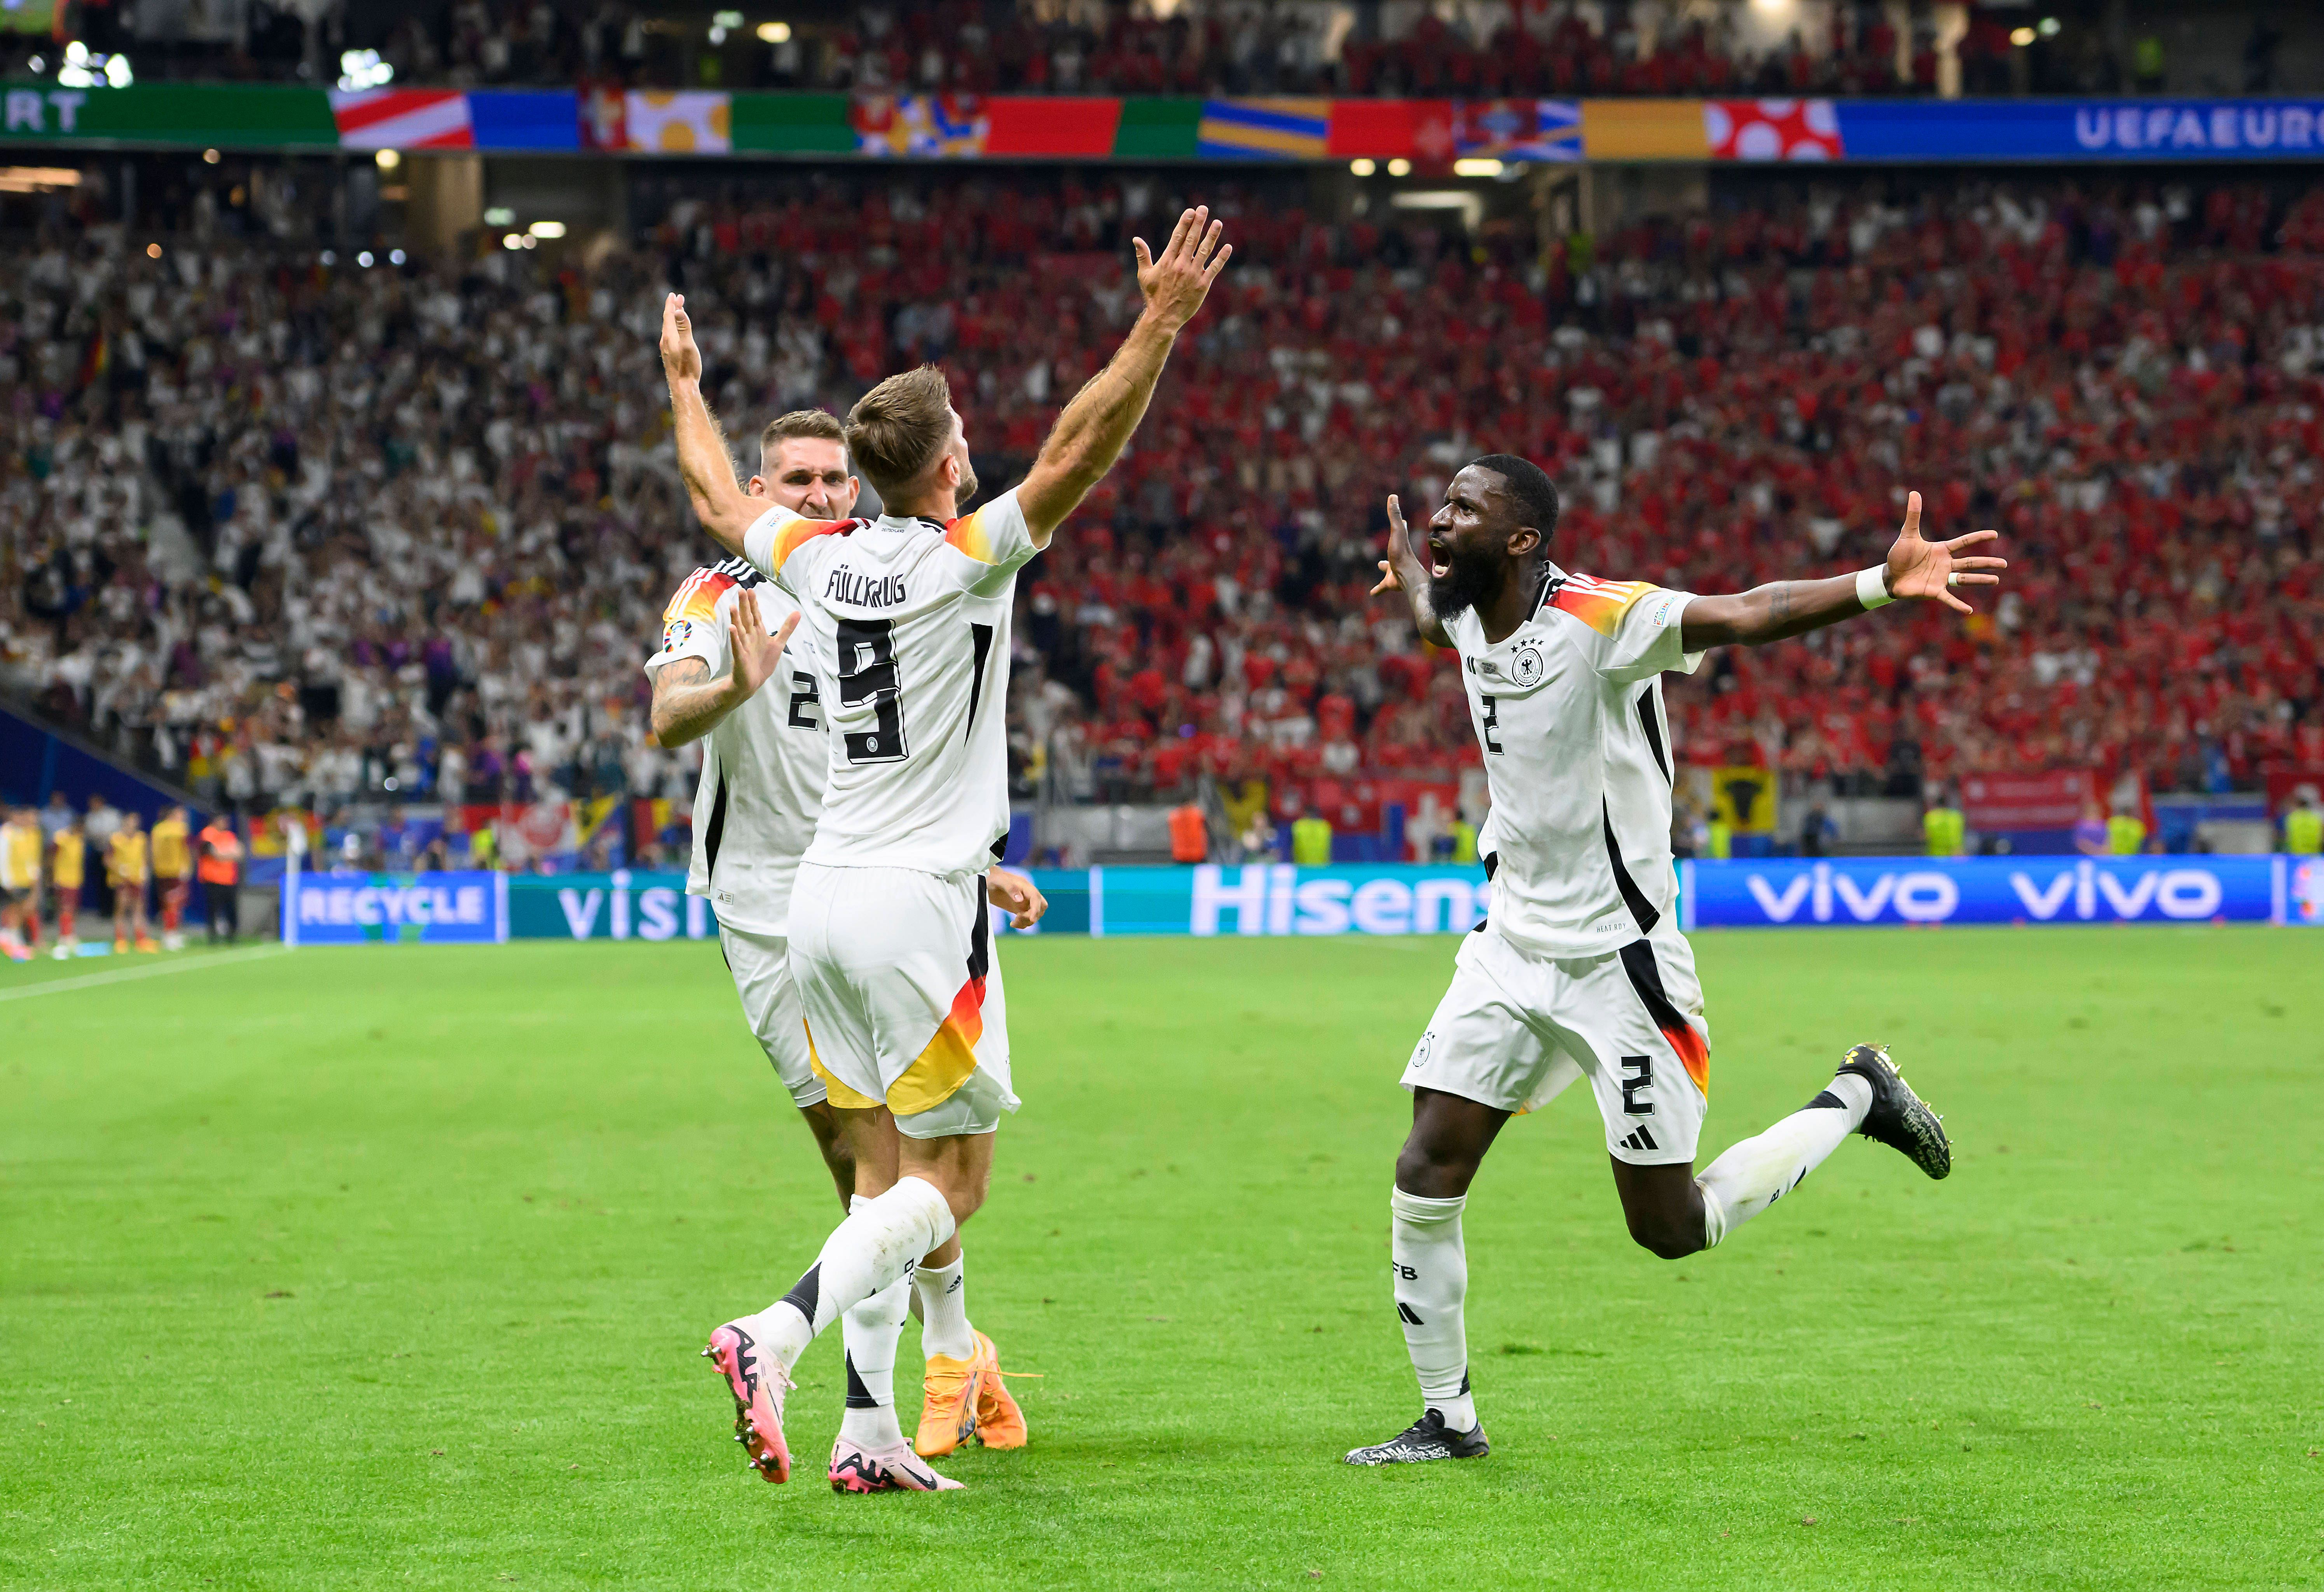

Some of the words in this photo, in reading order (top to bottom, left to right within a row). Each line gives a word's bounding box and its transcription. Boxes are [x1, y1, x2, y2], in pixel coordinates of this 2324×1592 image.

[824, 564, 906, 608] FÜLLKRUG
[788, 671, 830, 732] 2
[836, 619, 910, 765] 9
[1481, 695, 1505, 755] 2
[301, 886, 485, 925] RECYCLE
[1190, 863, 1492, 936] Hisen
[1746, 861, 1960, 922] vivo
[2010, 860, 2222, 920] vivo
[1621, 1055, 1655, 1116] 2
